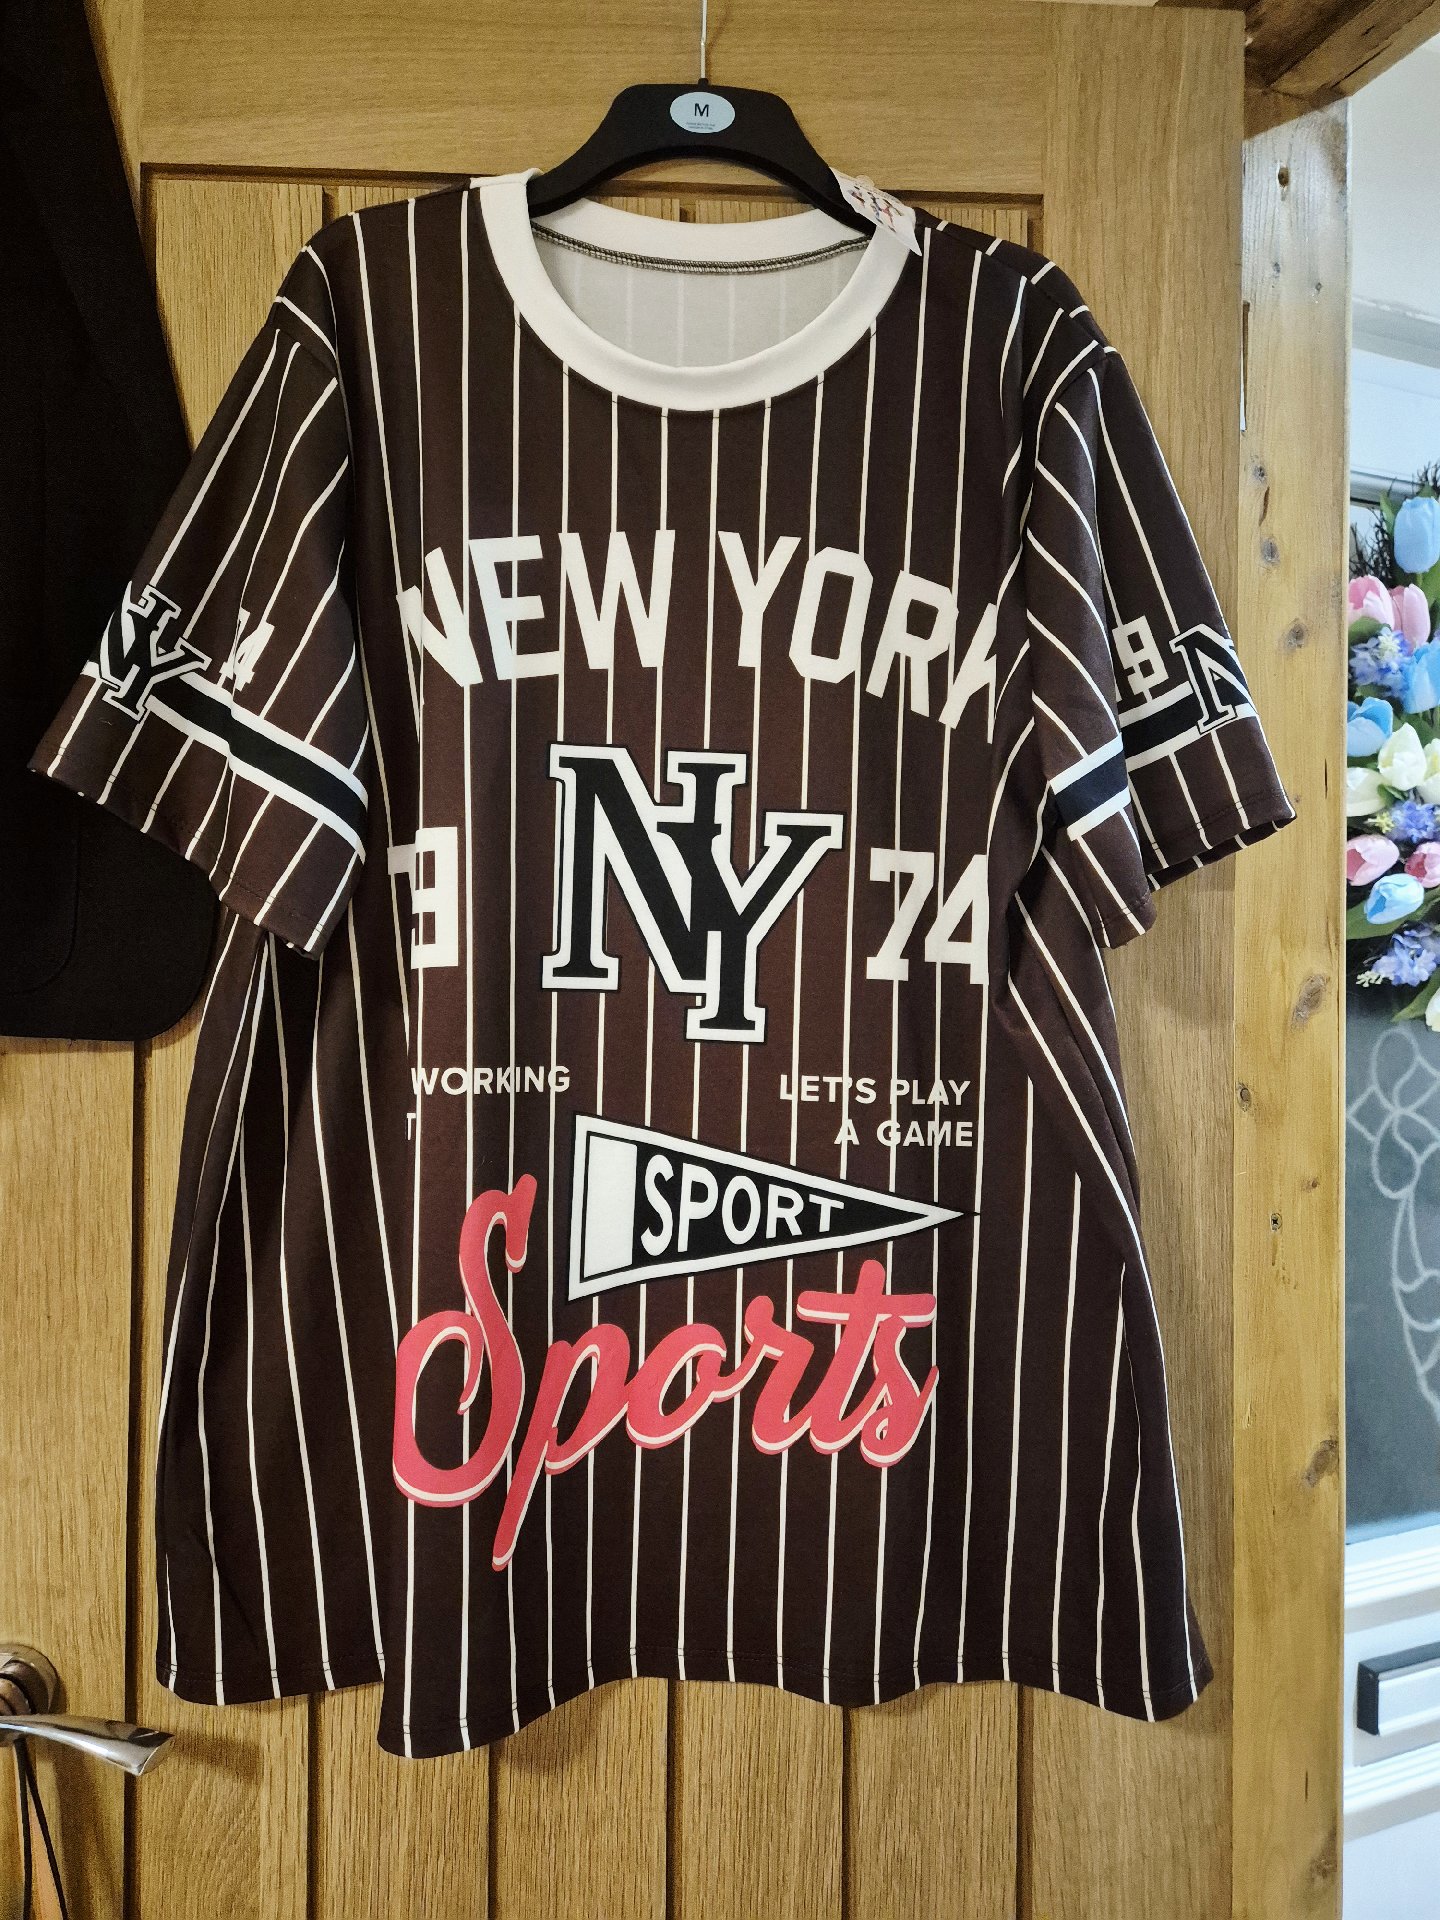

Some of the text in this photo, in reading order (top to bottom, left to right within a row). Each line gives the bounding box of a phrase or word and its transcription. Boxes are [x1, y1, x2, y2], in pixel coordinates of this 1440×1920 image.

[694, 103, 709, 117] M
[396, 529, 676, 687] NEW
[1112, 615, 1169, 698] 9
[542, 743, 844, 1043] NY
[866, 847, 989, 985] 74
[410, 1065, 571, 1096] WORKING
[779, 1074, 971, 1106] LET'S PLAY
[834, 1119, 973, 1147] A GAME
[640, 1154, 845, 1256] SPORT
[392, 1174, 940, 1571] Sports
